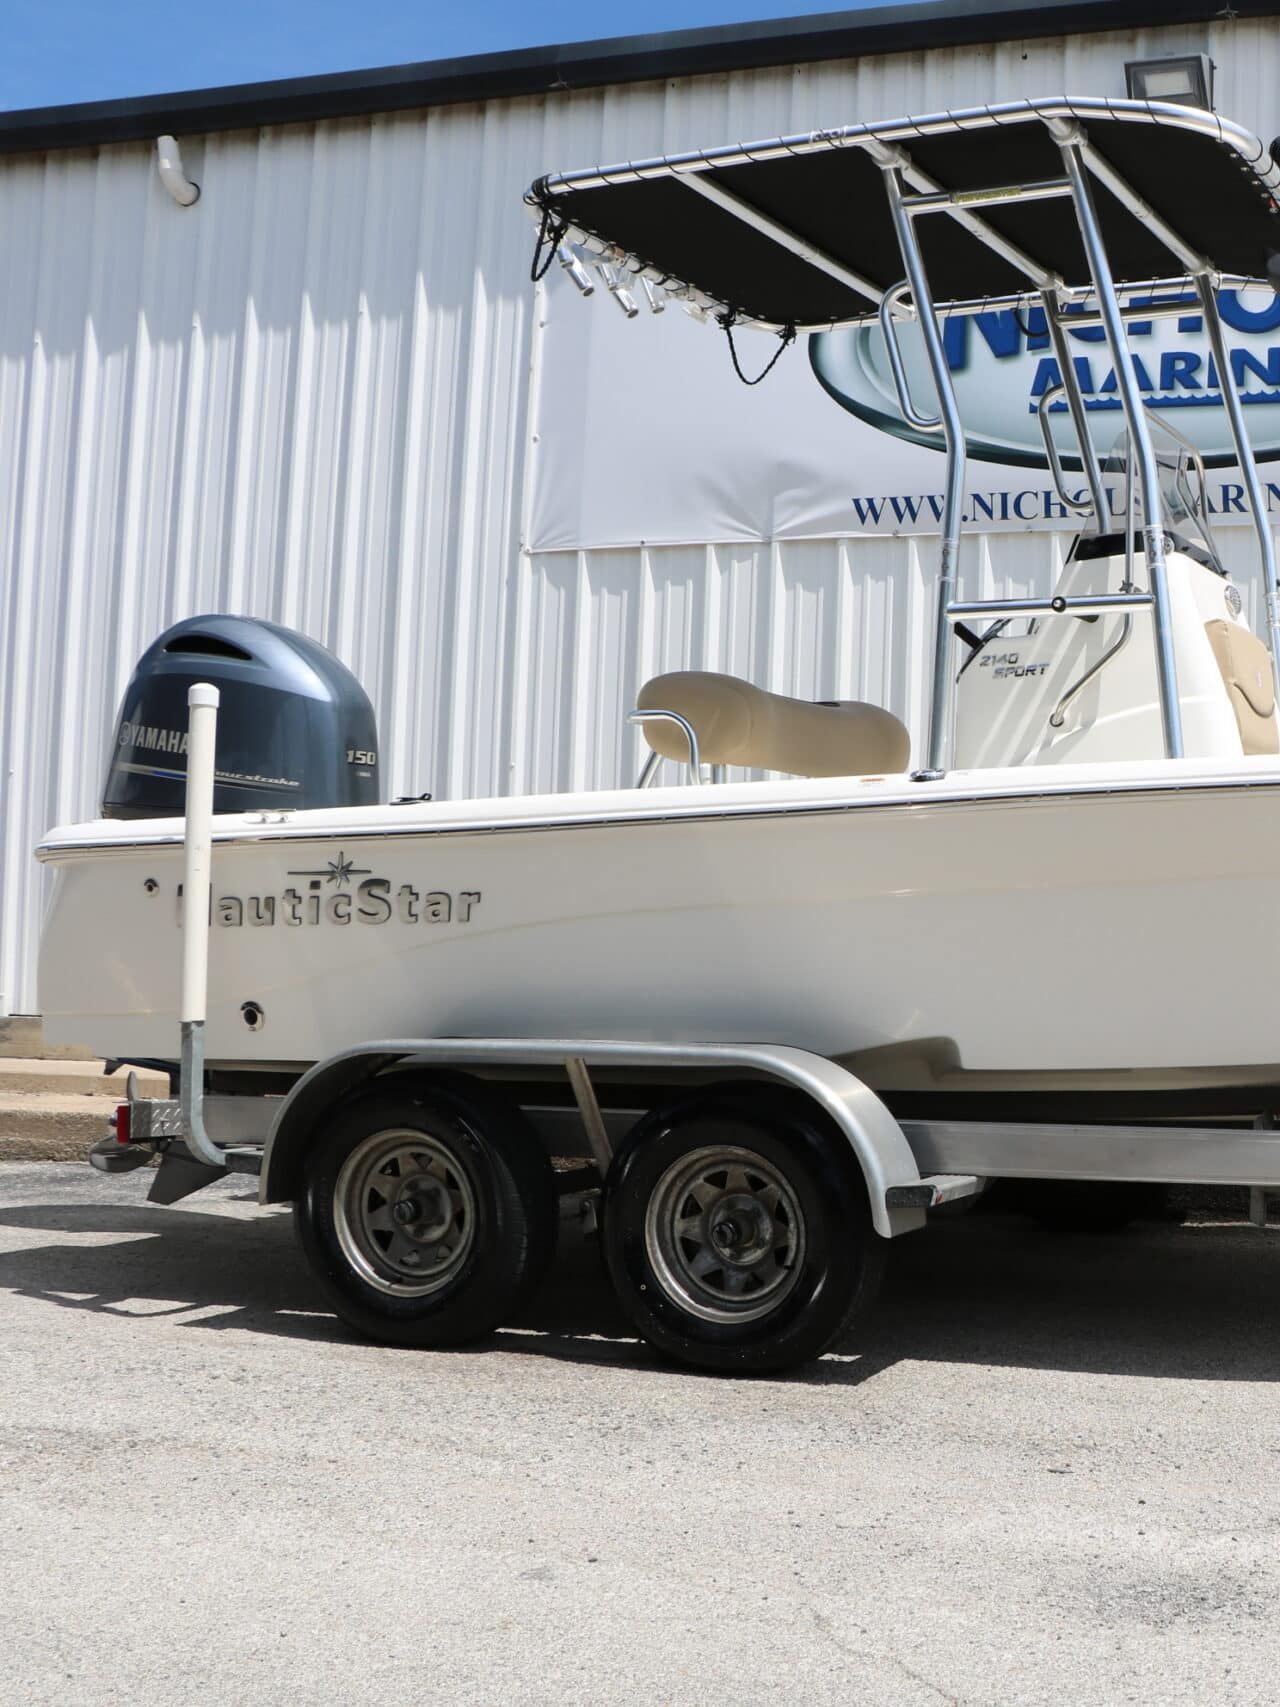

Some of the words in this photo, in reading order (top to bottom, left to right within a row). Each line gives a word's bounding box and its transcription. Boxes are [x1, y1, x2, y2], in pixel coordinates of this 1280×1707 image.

[992, 663, 1050, 679] SPORT
[130, 724, 190, 754] YAMAHA
[346, 750, 377, 765] 150
[214, 770, 300, 787] ourstroke
